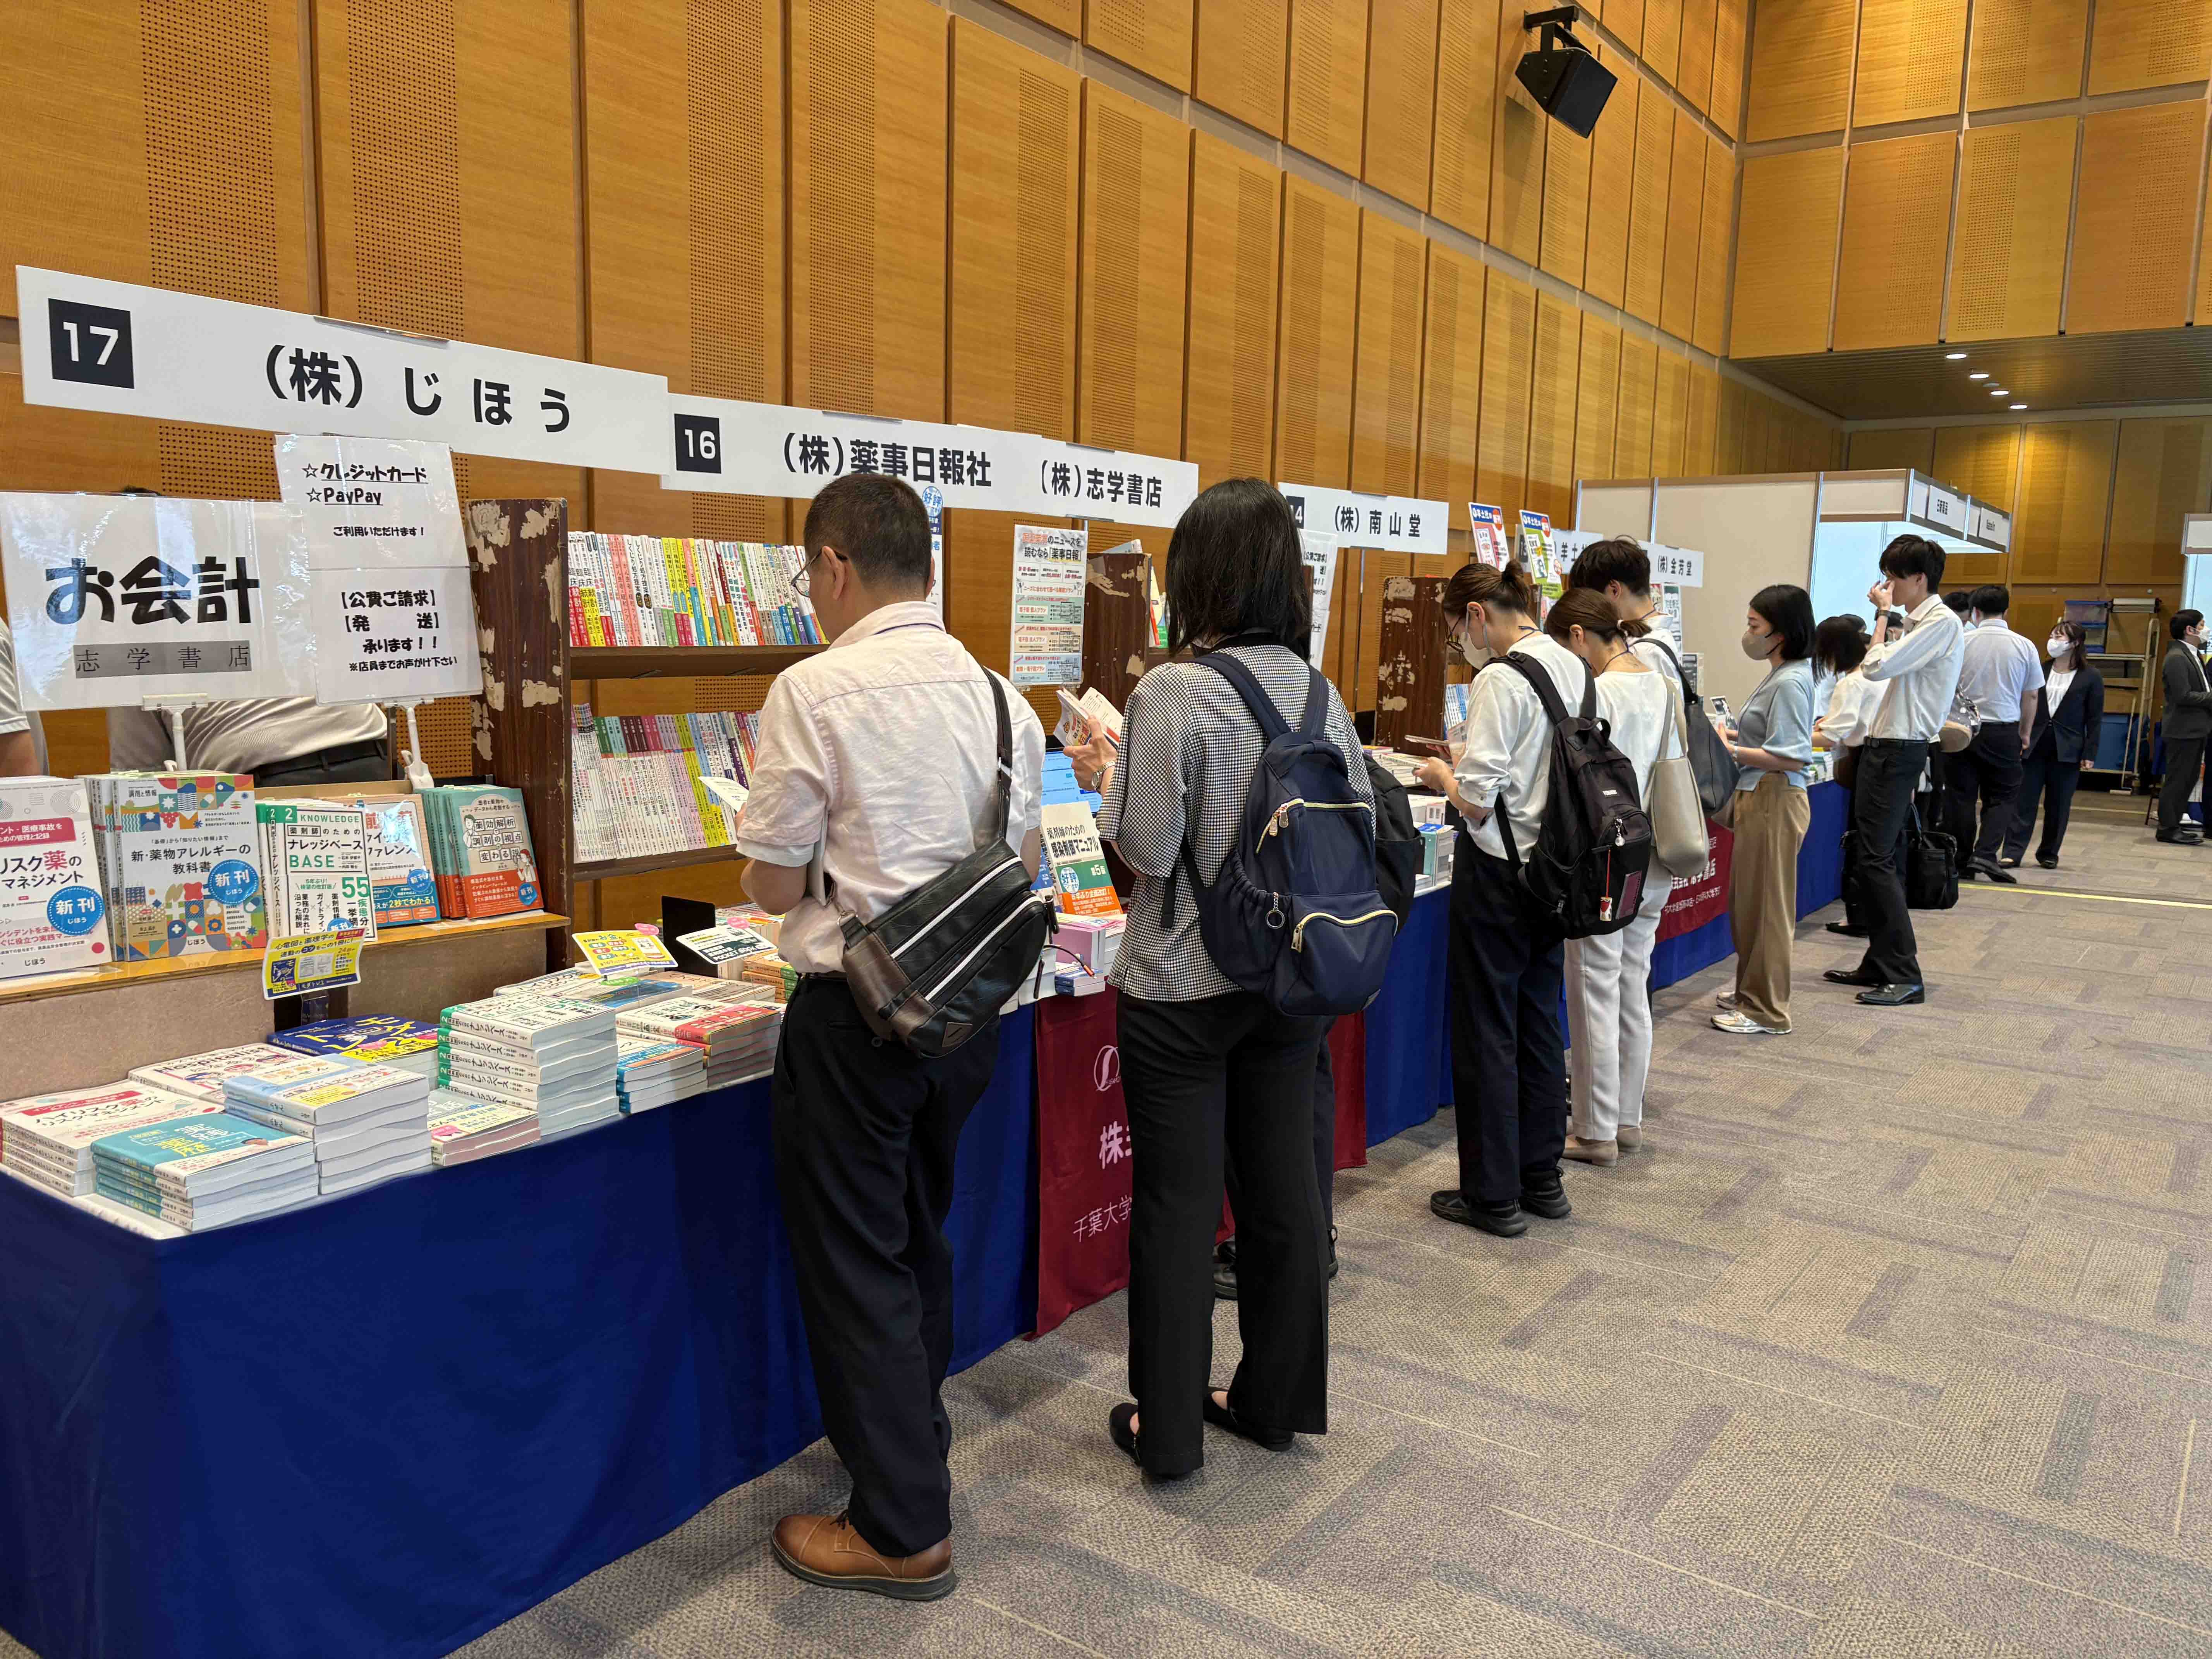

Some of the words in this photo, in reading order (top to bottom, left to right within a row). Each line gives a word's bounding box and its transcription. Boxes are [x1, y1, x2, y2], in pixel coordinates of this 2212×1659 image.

[63, 321, 119, 365] 17
[684, 429, 716, 460] 16
[321, 464, 427, 483] クレジットカード
[324, 487, 382, 505] PayPay
[1290, 505, 1302, 523] 4
[333, 526, 424, 537] ご利用いただけます！
[45, 556, 260, 625] お会計
[341, 591, 436, 609] 【公費ご請求】
[363, 636, 437, 654] 承ります！！
[76, 646, 249, 673] 志学書店
[285, 808, 293, 820] 2
[301, 814, 360, 823] KNOWLEDGE
[476, 818, 514, 830] 薬効解析
[290, 827, 360, 835] 薬剤師のための
[472, 833, 522, 846] 調剤の視点
[1047, 824, 1085, 840] 薬剤師のための
[288, 839, 363, 850] ナレッジベース
[172, 861, 212, 874] 教科書
[289, 855, 335, 868] BASE
[2, 870, 84, 890] マネジメント
[215, 869, 250, 887] 新刊
[341, 876, 371, 898] 55
[56, 896, 96, 915] 新刊
[24, 958, 45, 967] じほう
[1099, 1120, 1132, 1170] 株
[1073, 1194, 1132, 1243] 千葉大学
